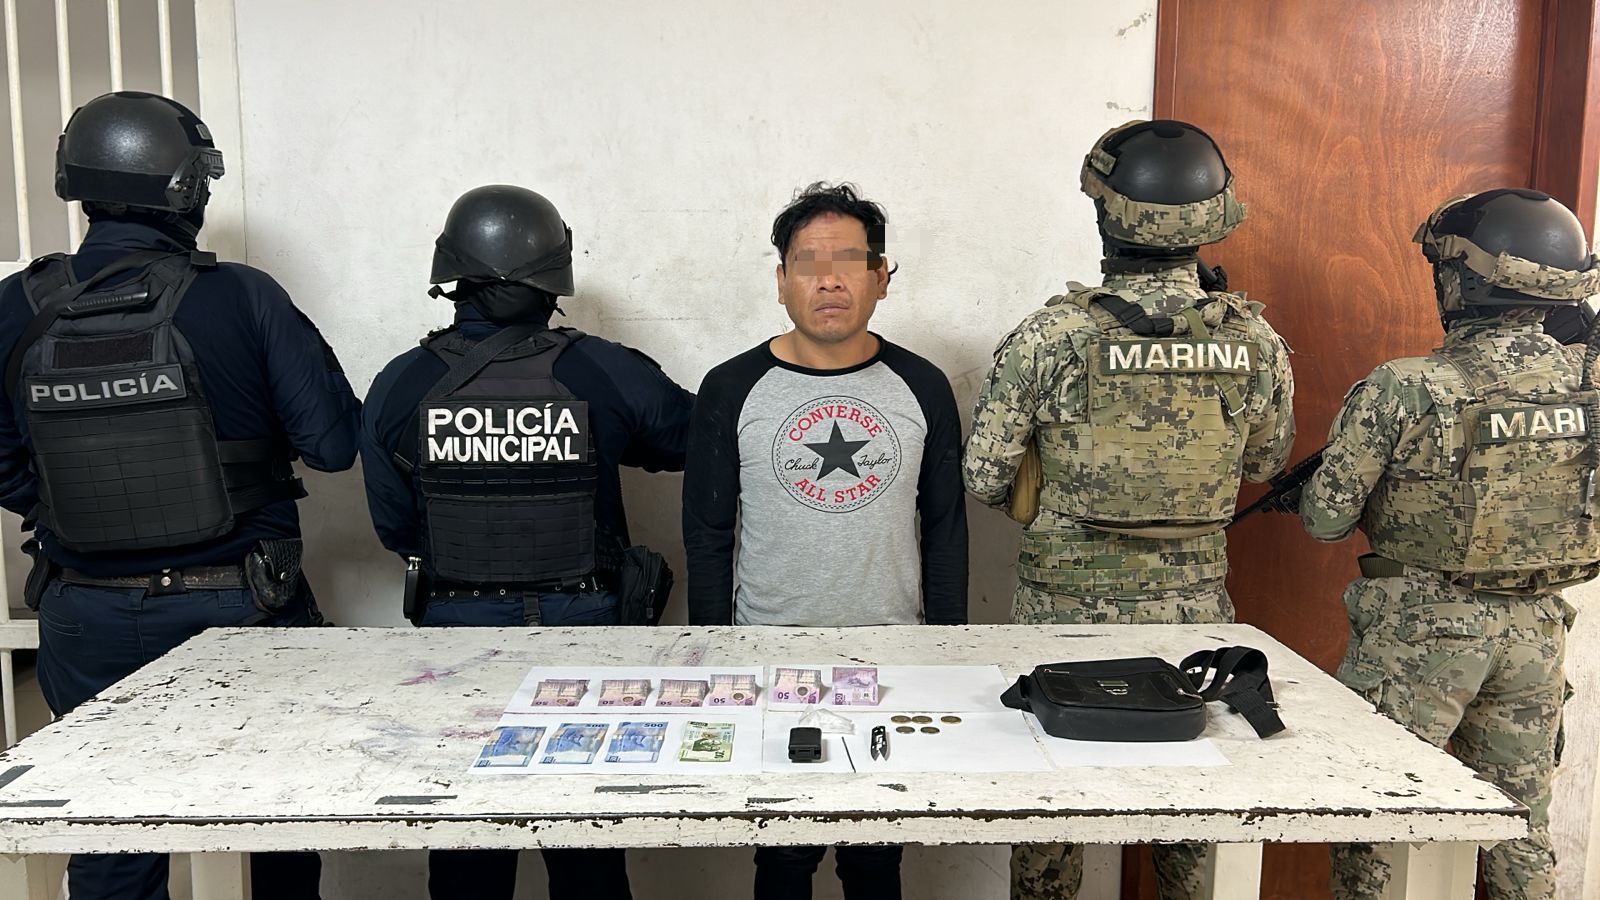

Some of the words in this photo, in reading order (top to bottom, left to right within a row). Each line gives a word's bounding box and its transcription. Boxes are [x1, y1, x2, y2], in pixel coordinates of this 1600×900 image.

[1109, 343, 1251, 371] MARINA
[30, 373, 178, 402] POLICÍA
[428, 403, 580, 435] POLICÍA
[789, 405, 883, 441] CONVERSE
[428, 435, 580, 463] MUNICIPAL
[785, 457, 820, 471] Chuck
[857, 453, 892, 469] Taylor
[795, 478, 826, 502] ALL
[835, 474, 881, 503] STAR
[777, 691, 790, 700] 50
